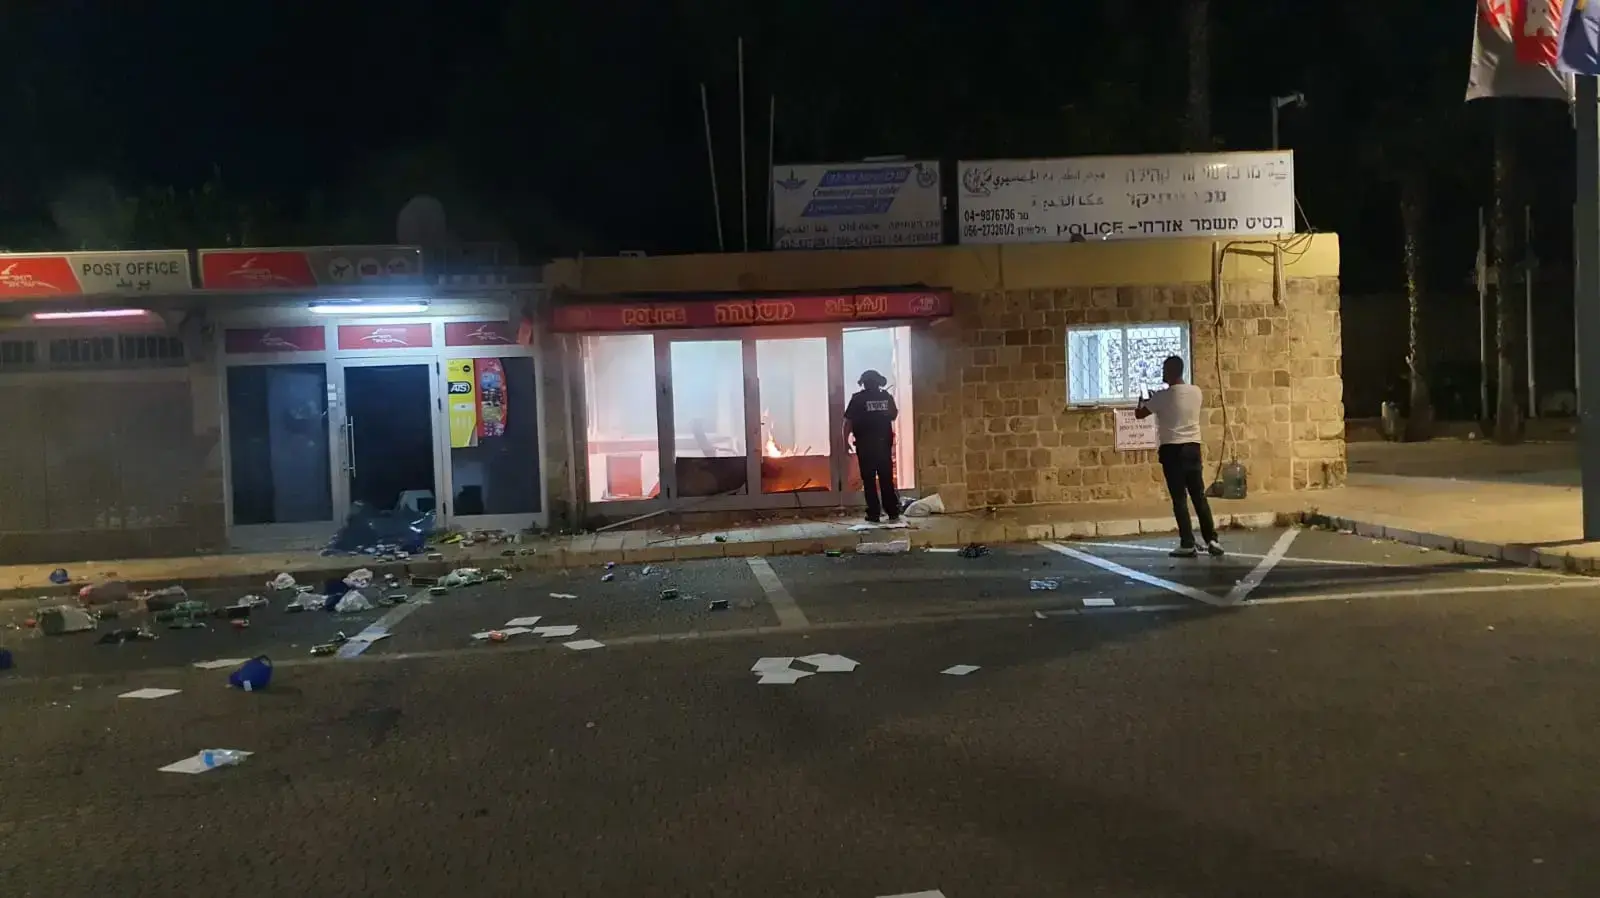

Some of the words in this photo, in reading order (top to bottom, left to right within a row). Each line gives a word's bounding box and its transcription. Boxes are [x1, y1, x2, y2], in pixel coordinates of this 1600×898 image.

[1189, 217, 1238, 231] משמר
[82, 263, 120, 276] POST
[126, 261, 179, 275] OFFICE
[714, 302, 795, 324] משטרה
[825, 296, 888, 317] الشرطة
[622, 308, 686, 325] POLICE
